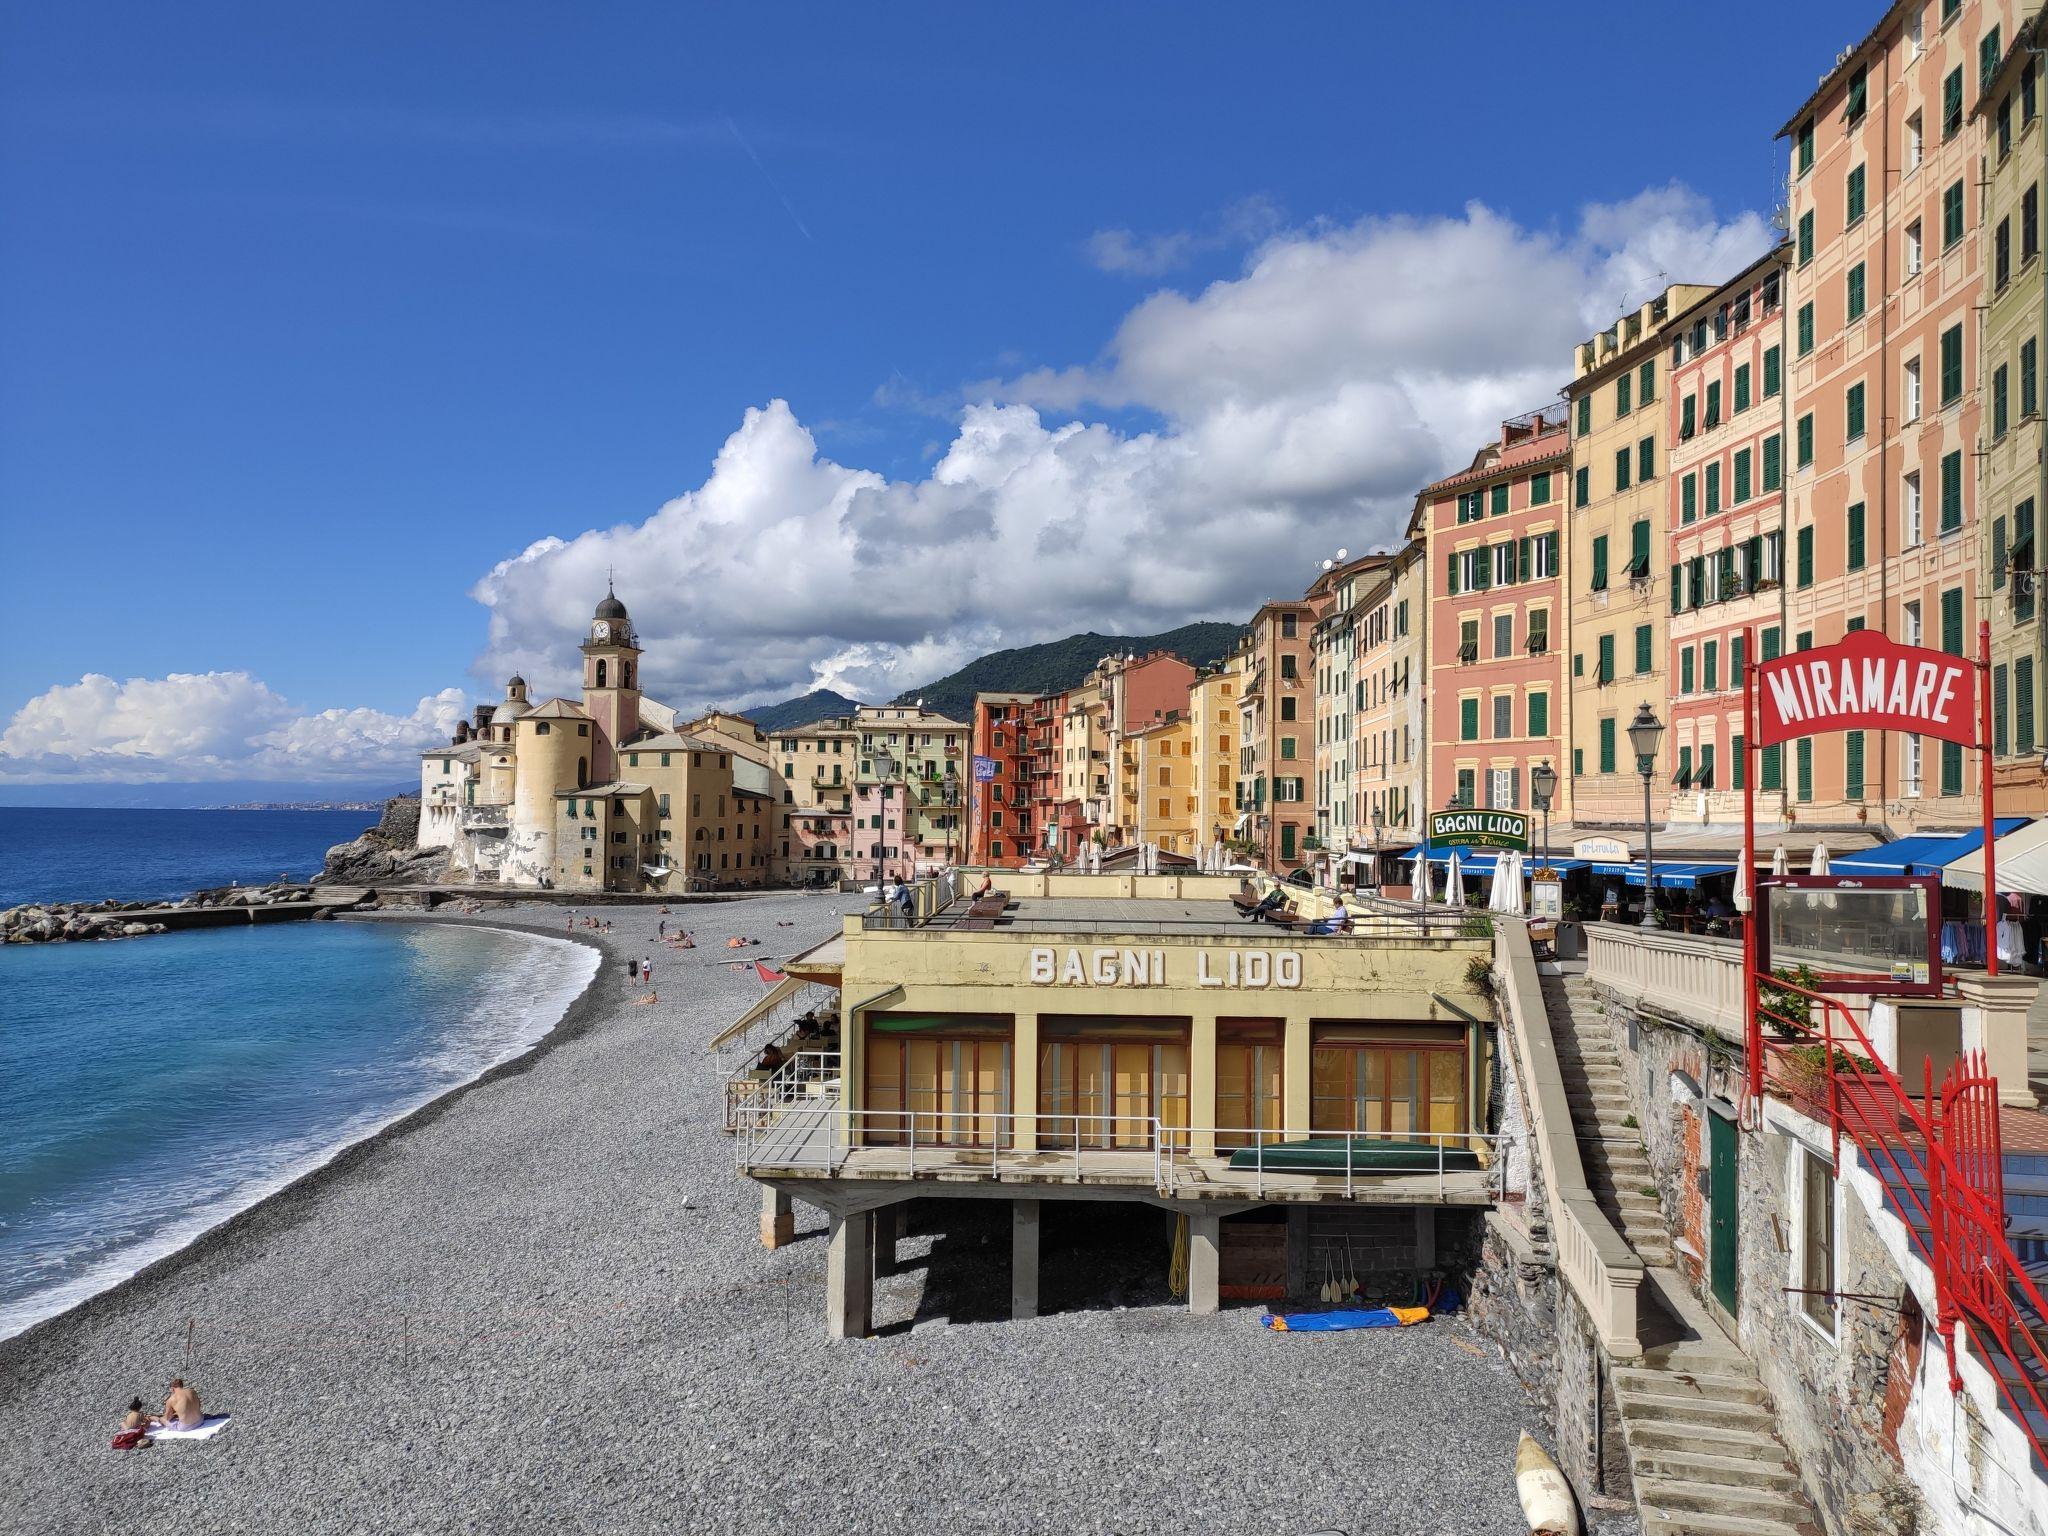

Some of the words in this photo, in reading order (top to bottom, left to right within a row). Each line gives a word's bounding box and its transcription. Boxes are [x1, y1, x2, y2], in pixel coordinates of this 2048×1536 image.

[1766, 657, 1963, 726] MIRAMARE
[1435, 815, 1483, 834] BAGNI
[1488, 815, 1523, 835] LIDO
[1030, 948, 1165, 986] BAGNI
[1198, 950, 1303, 988] LIDO
